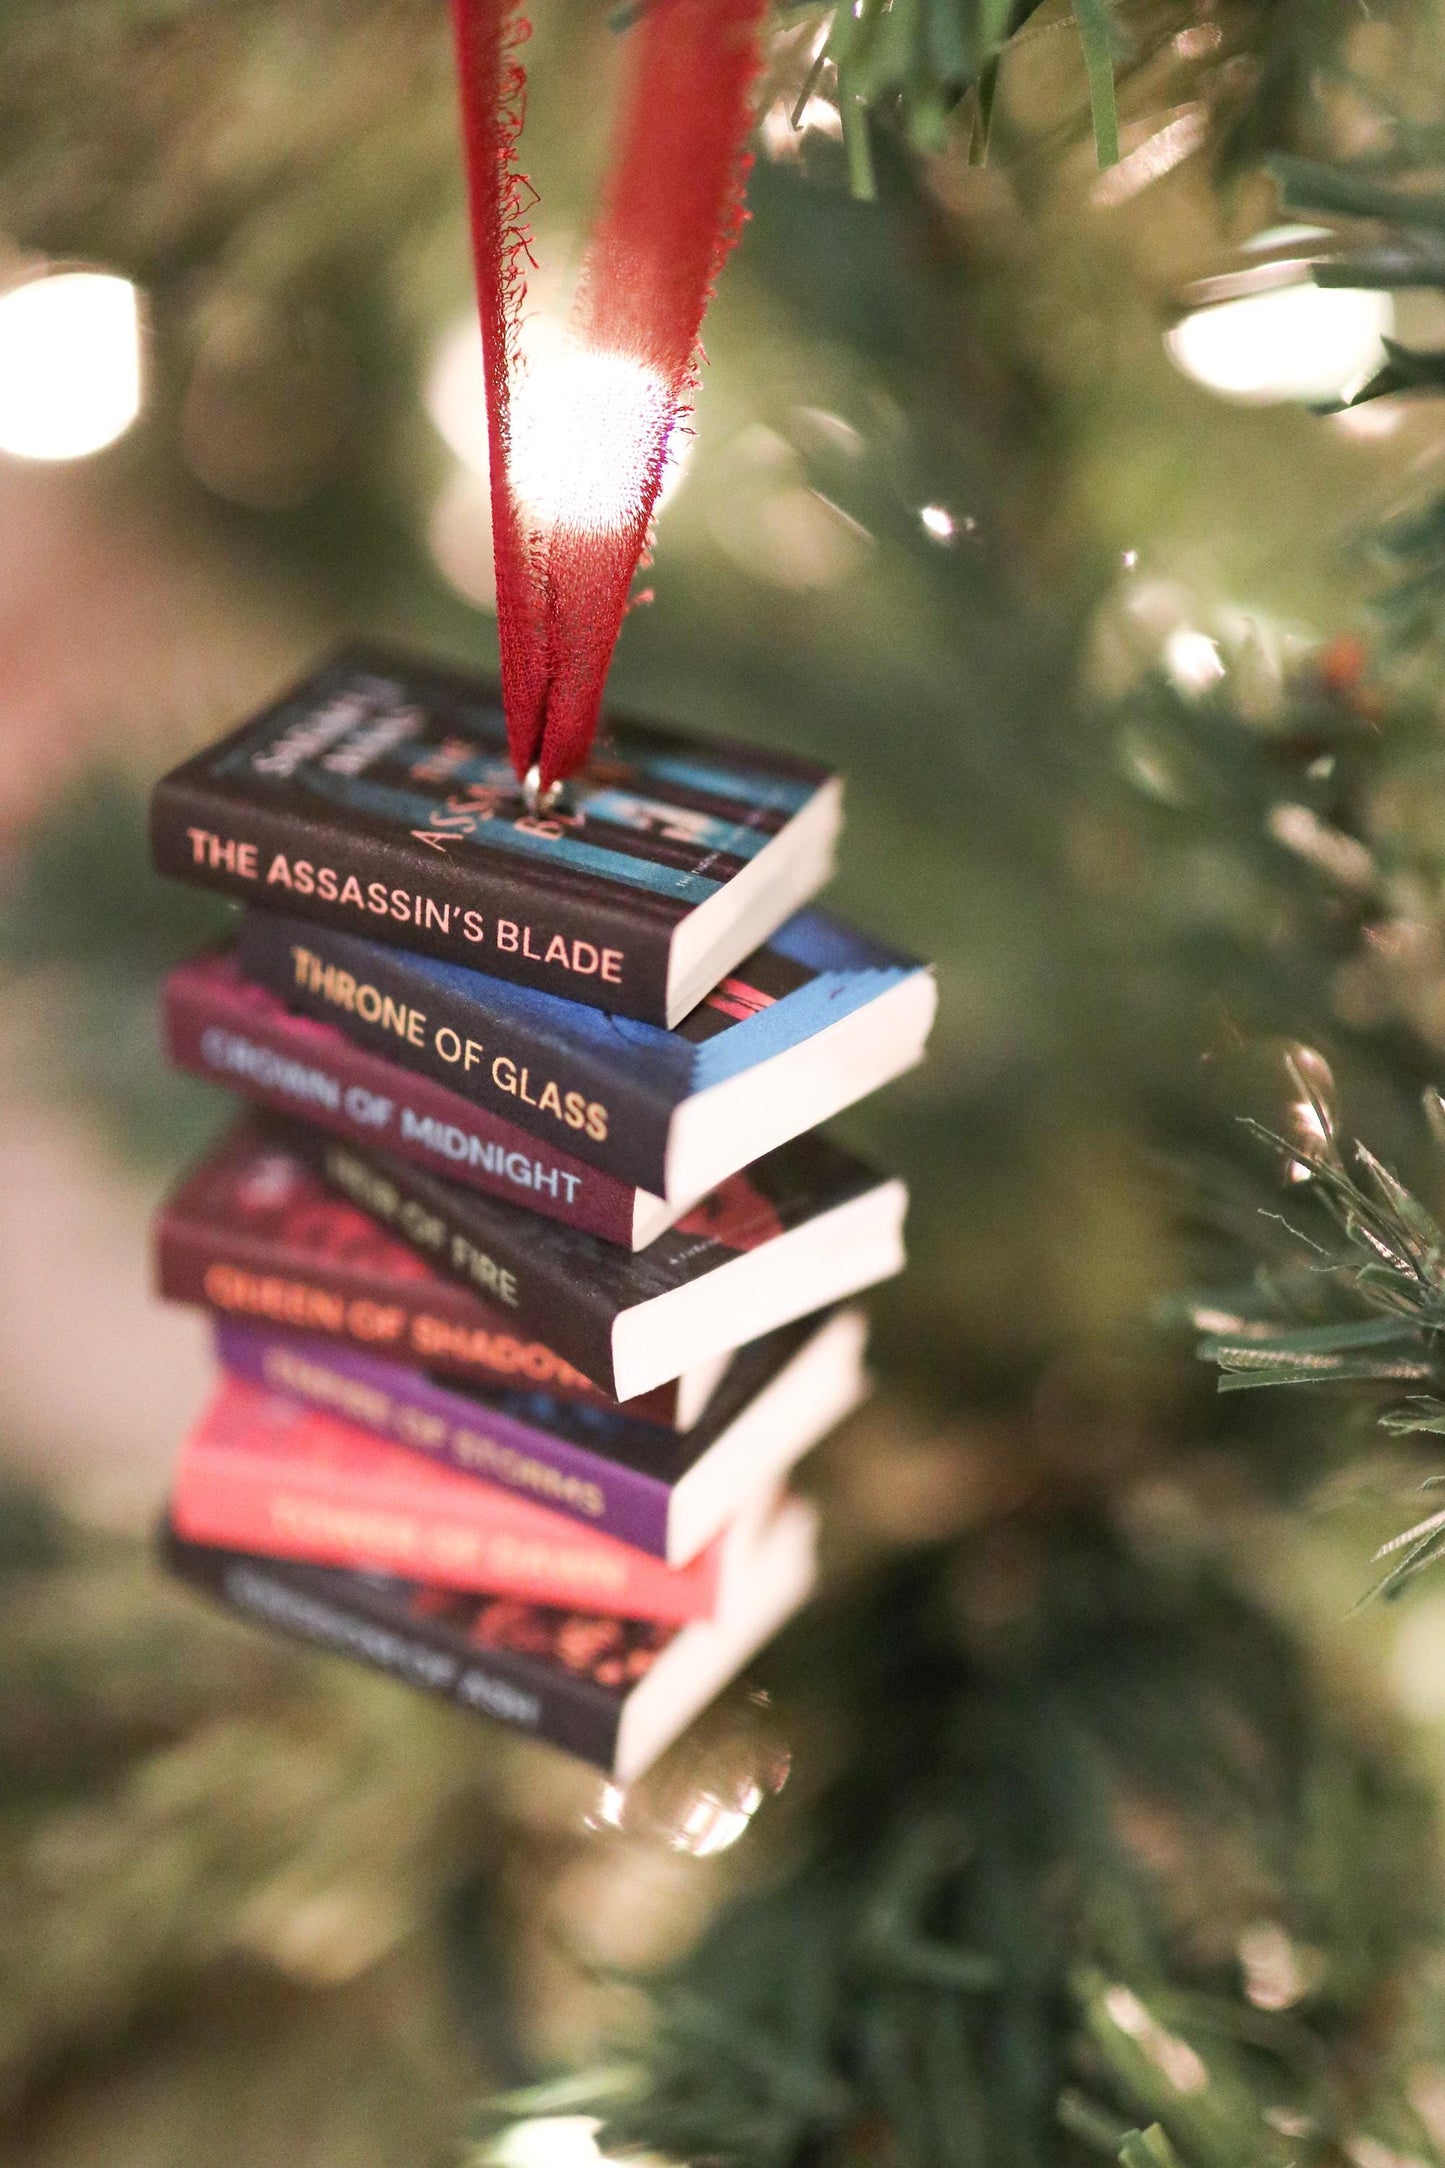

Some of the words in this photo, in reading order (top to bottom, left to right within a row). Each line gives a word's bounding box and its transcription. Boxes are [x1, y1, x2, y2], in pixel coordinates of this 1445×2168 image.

[187, 827, 259, 879] THE
[267, 854, 484, 942] ASSASSIN'S
[497, 919, 625, 985] BLADE
[292, 945, 427, 1048] THRONE
[434, 1027, 484, 1071] OF
[491, 1056, 610, 1142] GLASS
[343, 1084, 396, 1128] OF
[401, 1107, 582, 1204] MIDNIGHT
[346, 1300, 404, 1342] OF
[452, 1234, 520, 1309] FIRE
